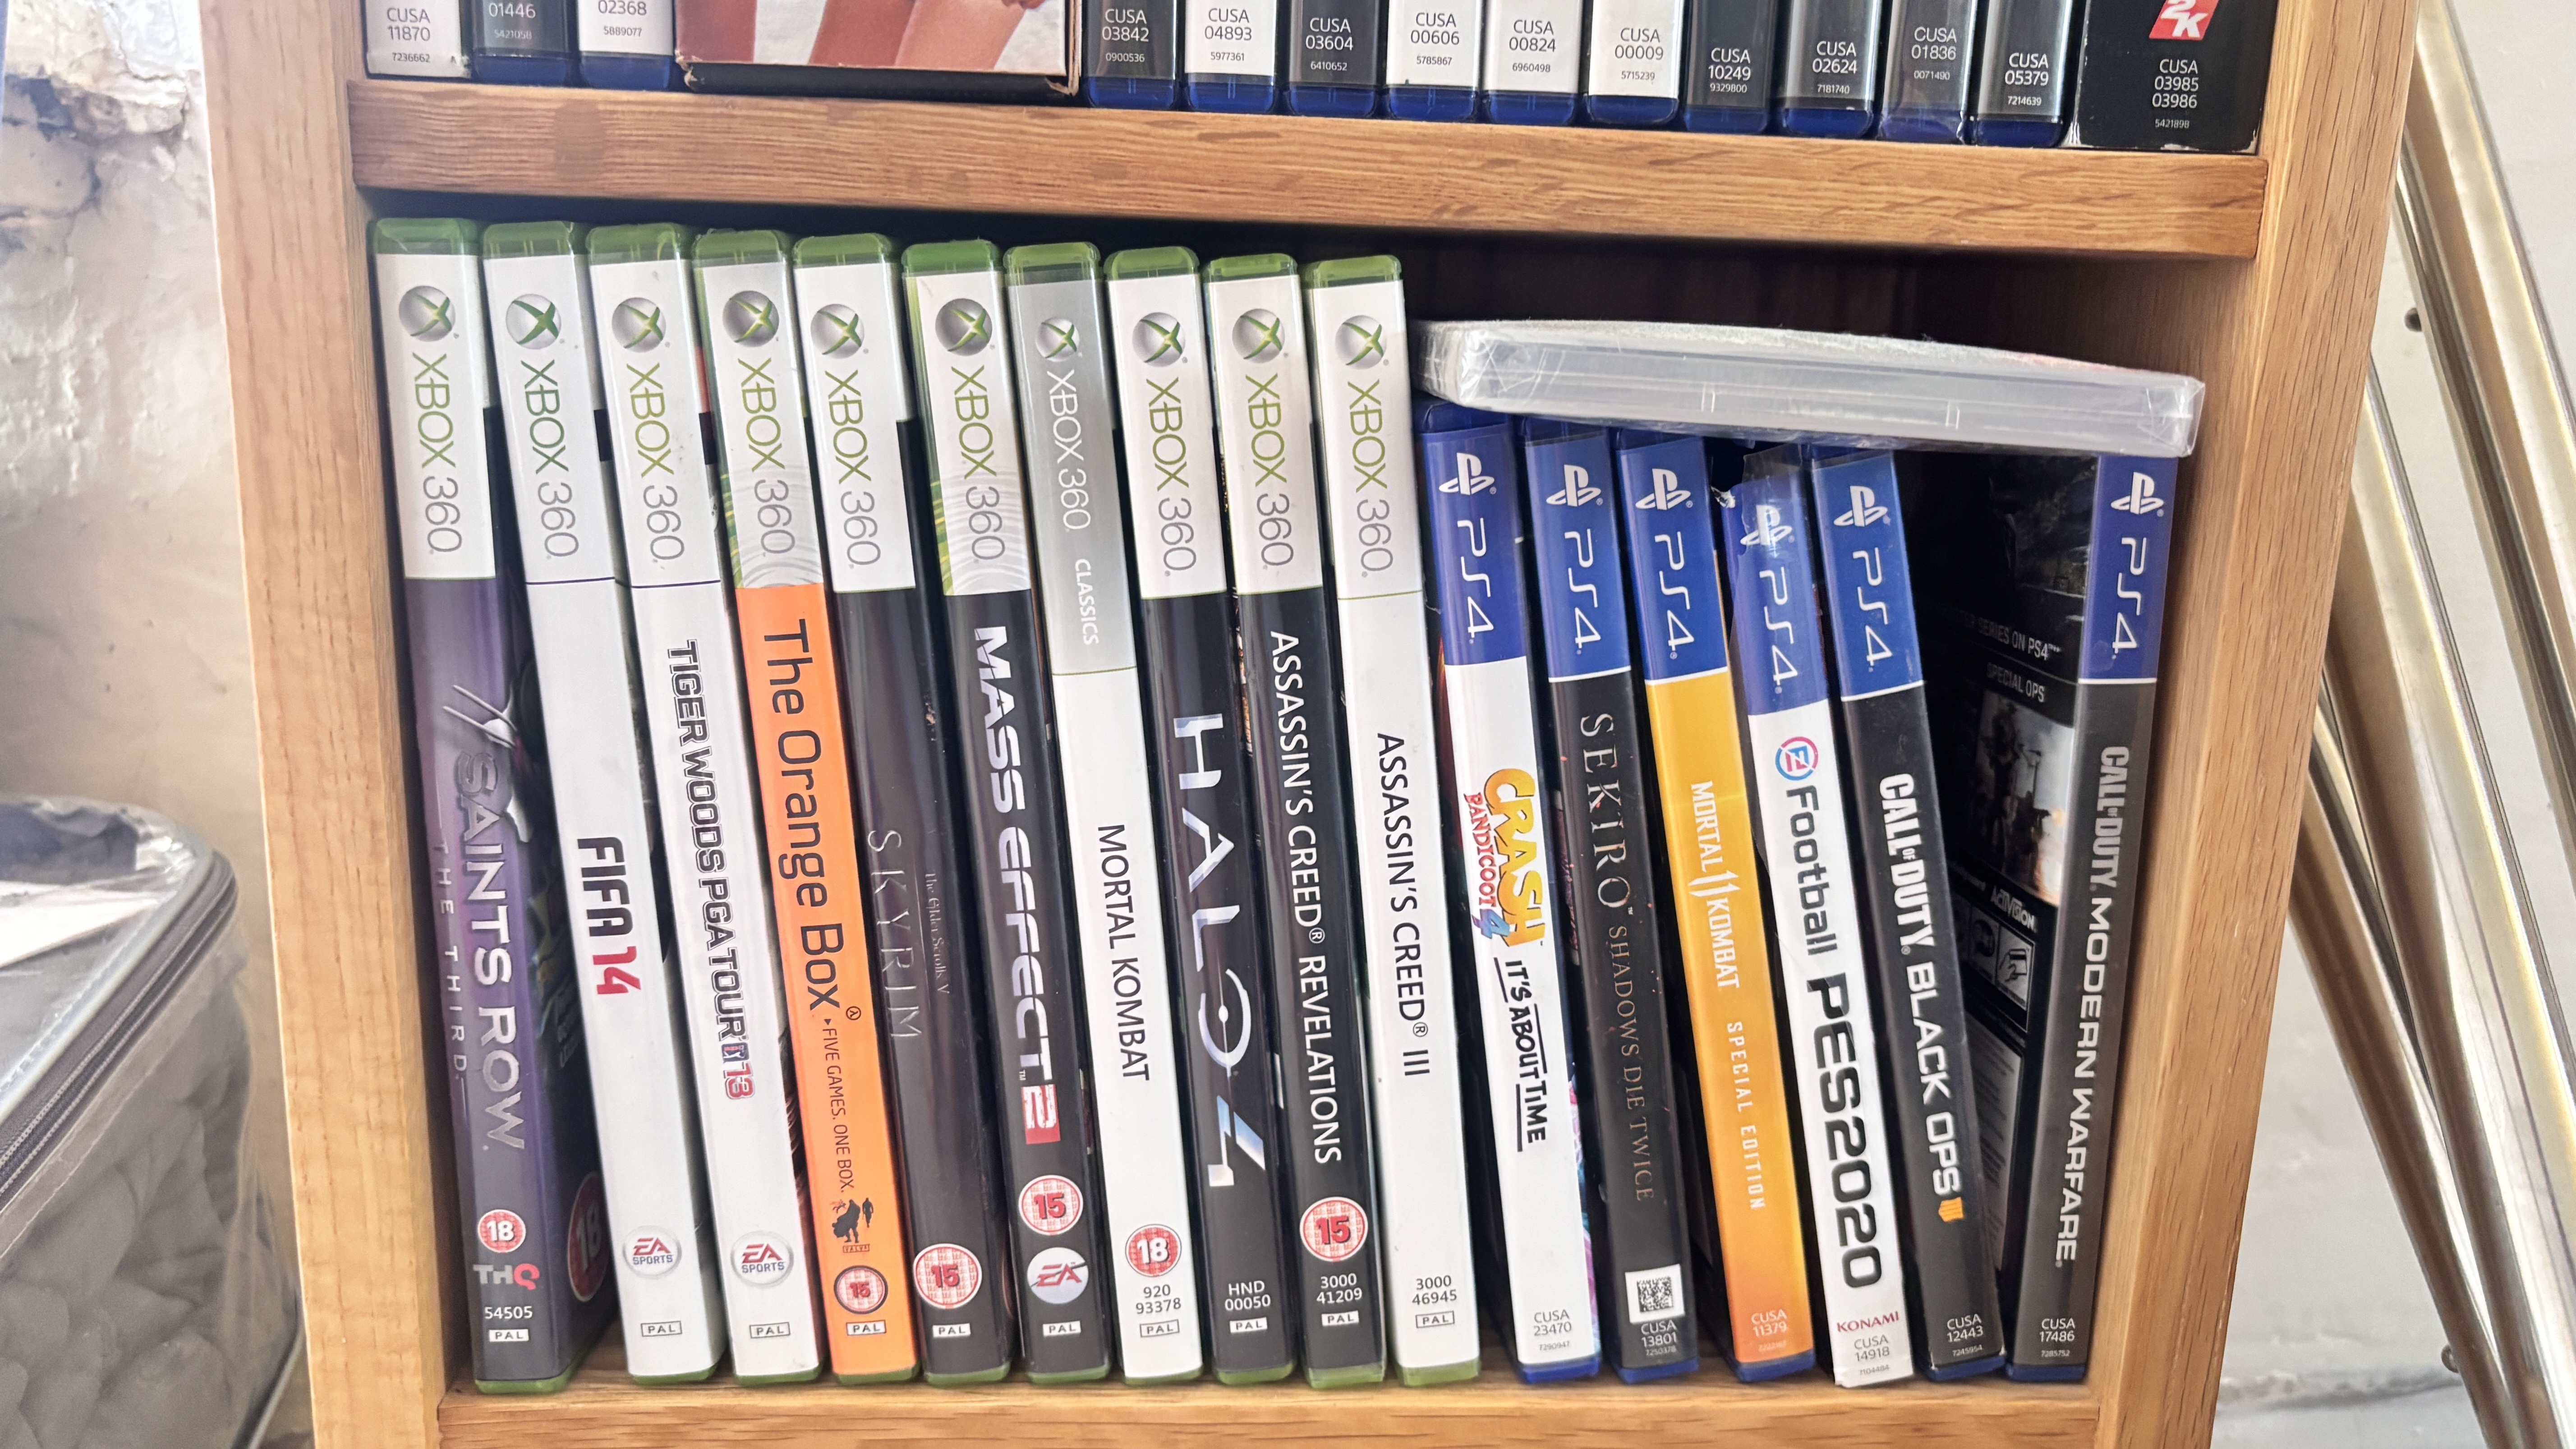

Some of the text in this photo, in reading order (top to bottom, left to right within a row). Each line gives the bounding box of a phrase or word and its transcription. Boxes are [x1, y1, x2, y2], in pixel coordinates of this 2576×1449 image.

[387, 7, 430, 23] CUSA
[488, 3, 536, 19] 01446
[598, 0, 647, 16] 02368
[1208, 8, 1249, 23] CUSA
[1105, 9, 1146, 24] CUSA
[1416, 12, 1456, 27] CUSA
[388, 26, 430, 41] 11870
[1205, 25, 1252, 41] 04893
[1310, 18, 1351, 33] CUSA
[1513, 19, 1554, 35] CUSA
[1102, 26, 1149, 42] 03842
[1411, 30, 1459, 45] 00606
[1620, 28, 1660, 43] CUSA
[1914, 27, 1956, 43] CUSA
[1306, 35, 1353, 51] 03604
[1509, 37, 1556, 52] 00824
[1817, 41, 1856, 56] CUSA
[392, 52, 430, 62] 7236662
[1106, 53, 1145, 62] 0900536
[1210, 52, 1245, 61] 5977361
[1615, 45, 1664, 60] 00009
[1711, 48, 1750, 64] CUSA
[1911, 45, 1956, 60] 01836
[1311, 61, 1347, 71] 6410652
[1812, 59, 1857, 74] 02624
[2009, 53, 2048, 69] CUSA
[2159, 59, 2198, 74] CUSA
[1621, 70, 1655, 80] 5715239
[1708, 65, 1751, 81] 10249
[2005, 70, 2048, 86] 05379
[2154, 77, 2199, 91] 03985
[2152, 93, 2197, 108] 03986
[412, 352, 463, 552] XBOX 360
[737, 357, 795, 555] XBOX 360
[1046, 369, 1091, 531] XBOX 360
[521, 359, 580, 558] XBOX 360
[626, 363, 685, 561] XBOX 360
[951, 365, 1005, 561] XBOX 360
[825, 370, 881, 566] XBOX 360
[1145, 377, 1197, 572] XBOX 360
[1245, 373, 1294, 567] XBOX 360
[1347, 379, 1394, 573] XBOX 360
[1458, 517, 1494, 638] PS4
[1564, 529, 1601, 649] PS4
[1655, 531, 1694, 651] PS4
[2112, 537, 2147, 654] PS4
[1075, 558, 1099, 645] CLASSICS
[1853, 547, 1893, 666] PS4
[1759, 566, 1798, 685] PS4
[667, 639, 709, 746] TIGER
[682, 746, 727, 872] WOODS
[764, 618, 844, 1010] The Orange Box
[1691, 781, 1723, 873] MORTAL
[1463, 792, 1496, 908] BANDICOOT
[1484, 768, 1546, 947] CRASH
[974, 626, 1059, 1128] MASS EFFECT 2
[1688, 870, 1740, 897] 11
[577, 837, 641, 995] FIFA 14
[699, 877, 736, 951] PGA
[1472, 908, 1510, 939] 4
[868, 830, 921, 1037] SKYRIM
[455, 752, 524, 1149] SAINTS ROW
[1173, 713, 1265, 1187] HALO 4
[1707, 897, 1739, 989] KOMBAT
[433, 843, 467, 1072] THE THIRD
[1098, 824, 1150, 1081] MORTAL KOMBAT
[1580, 713, 1654, 1201] SEKIRO SHADOWS DIE TWICE
[1880, 773, 1961, 1195] CALL BLACK OPS
[709, 947, 749, 1042] TOUR
[2056, 746, 2129, 1260] CALL DUTY MODERN WARFARE
[1299, 955, 1342, 1164] REVELATIONS
[1403, 1049, 1431, 1076] III
[723, 1062, 755, 1100] 13
[1509, 1006, 1547, 1143] ABOUT TIME
[823, 1028, 854, 1193] FIVE GAMES. ONE BOX.
[1727, 1021, 1765, 1210] SPECIAL EDITION
[1807, 972, 1881, 1288] PES2020
[1034, 1192, 1066, 1219] 15
[487, 1220, 515, 1241] 18
[1316, 1215, 1351, 1246] 15
[1137, 1237, 1169, 1264] 18
[633, 1255, 673, 1265] SPORTS
[742, 1262, 785, 1273] SPORTS
[473, 1263, 539, 1290] THQ
[931, 1264, 960, 1288] 15
[1320, 1273, 1357, 1288] 3000
[1416, 1275, 1452, 1291] 3000
[1143, 1284, 1170, 1298] 920
[1228, 1280, 1265, 1297] HND
[1316, 1288, 1362, 1304] 41209
[1136, 1297, 1182, 1314] 93378
[1224, 1294, 1271, 1311] 00050
[1412, 1289, 1457, 1306] 46945
[485, 1306, 533, 1319] 54505
[1327, 1314, 1355, 1324] PAL
[1422, 1315, 1449, 1326] PAL
[1534, 1309, 1569, 1322] CUSA
[1751, 1309, 1787, 1325] CUSA
[648, 1325, 676, 1334] PAL
[853, 1323, 881, 1333] PAL
[1049, 1324, 1076, 1333] PAL
[1147, 1323, 1173, 1334] PAL
[1236, 1321, 1263, 1330] PAL
[1534, 1321, 1572, 1335] 23470
[1641, 1320, 1677, 1335] CUSA
[1837, 1311, 1899, 1333] KONAMI
[1947, 1314, 1982, 1330] CUSA
[2041, 1318, 2075, 1329] CUSA
[495, 1331, 524, 1340] PAL
[756, 1326, 784, 1336] PAL
[938, 1326, 966, 1335] PAL
[1947, 1325, 1983, 1343] 12443
[2039, 1331, 2075, 1342] 17486
[1641, 1332, 1678, 1348] 13801
[1854, 1334, 1888, 1350] CUSA
[1855, 1346, 1890, 1362] 14918
